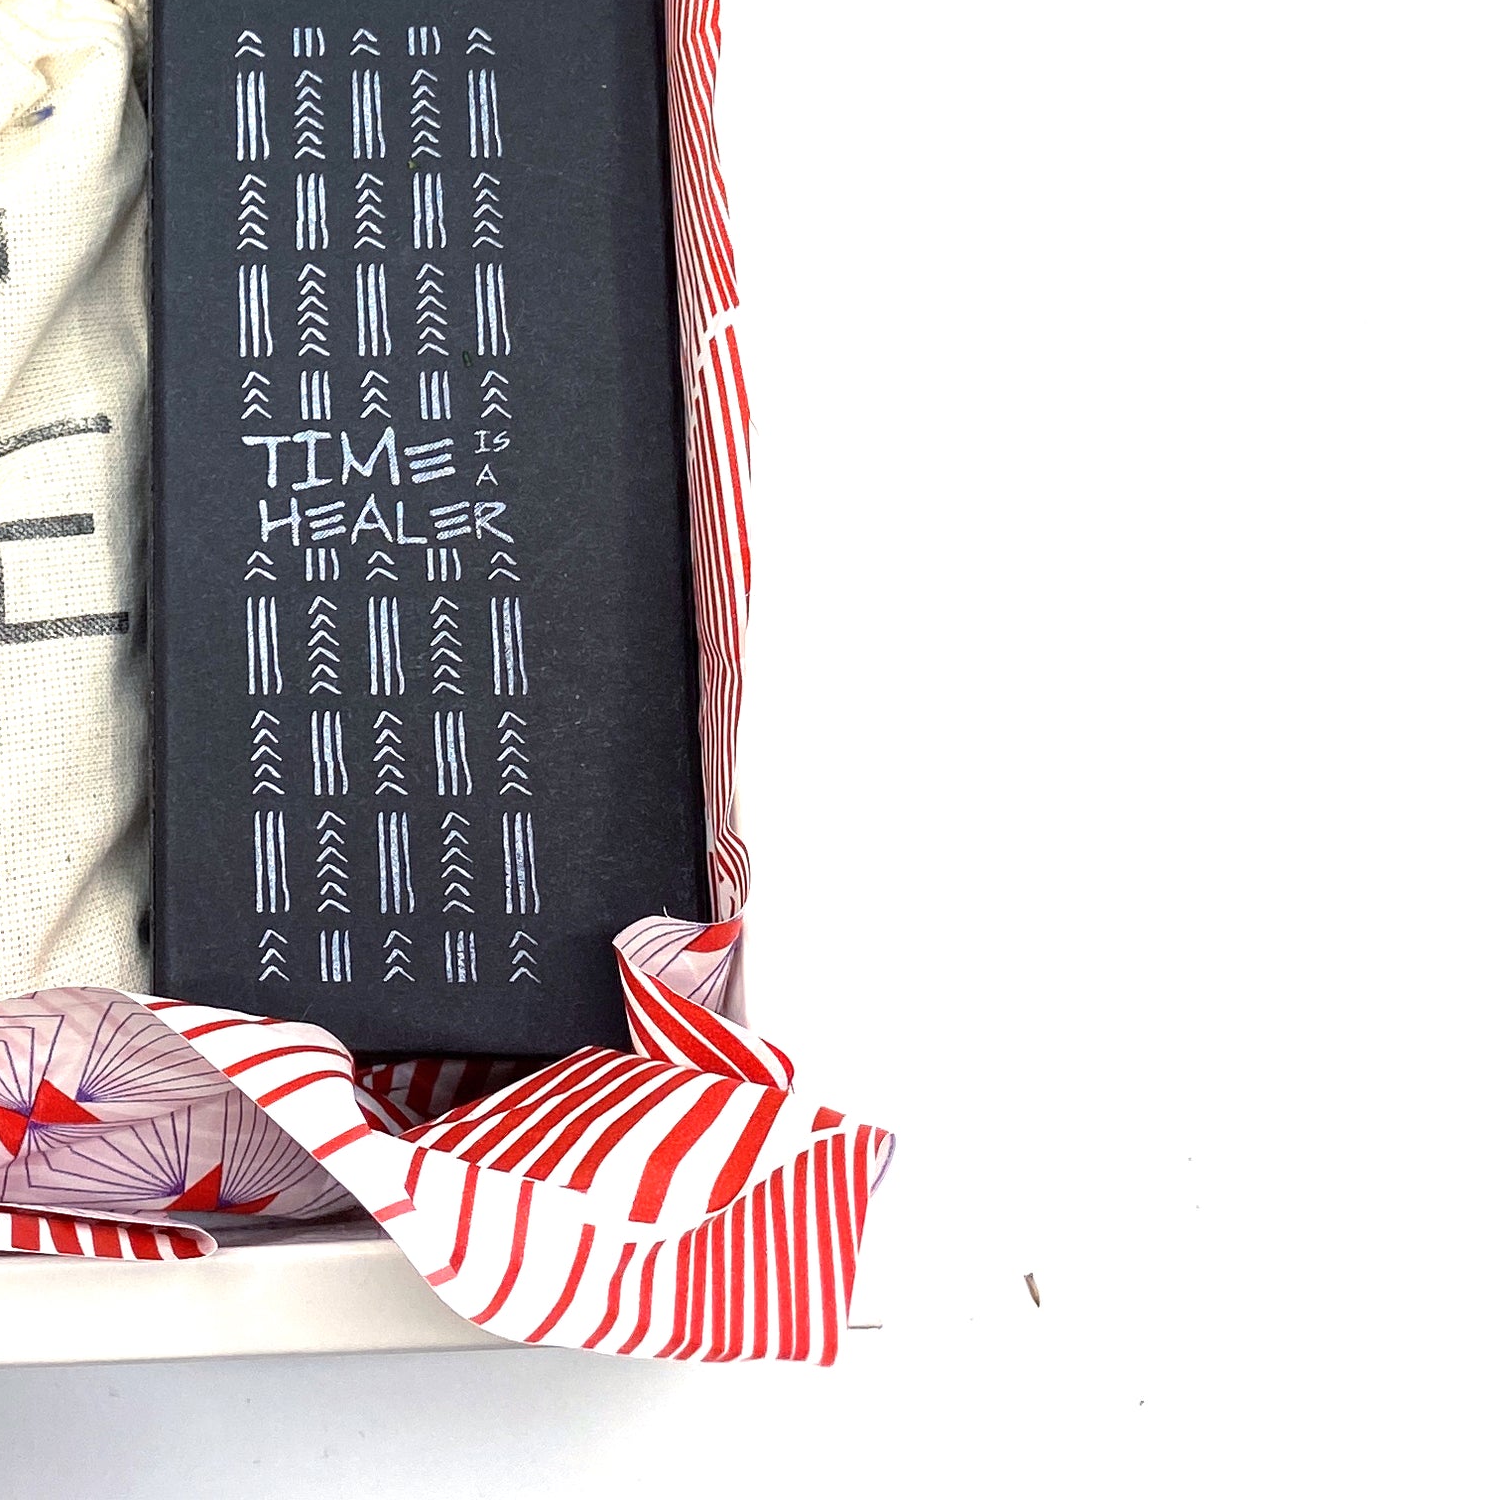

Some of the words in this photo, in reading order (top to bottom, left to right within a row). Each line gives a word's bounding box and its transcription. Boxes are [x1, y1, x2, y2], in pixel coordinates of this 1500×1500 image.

[241, 426, 456, 491] TIME
[474, 429, 511, 453] IS
[475, 463, 498, 487] A
[258, 493, 514, 546] HEALER
